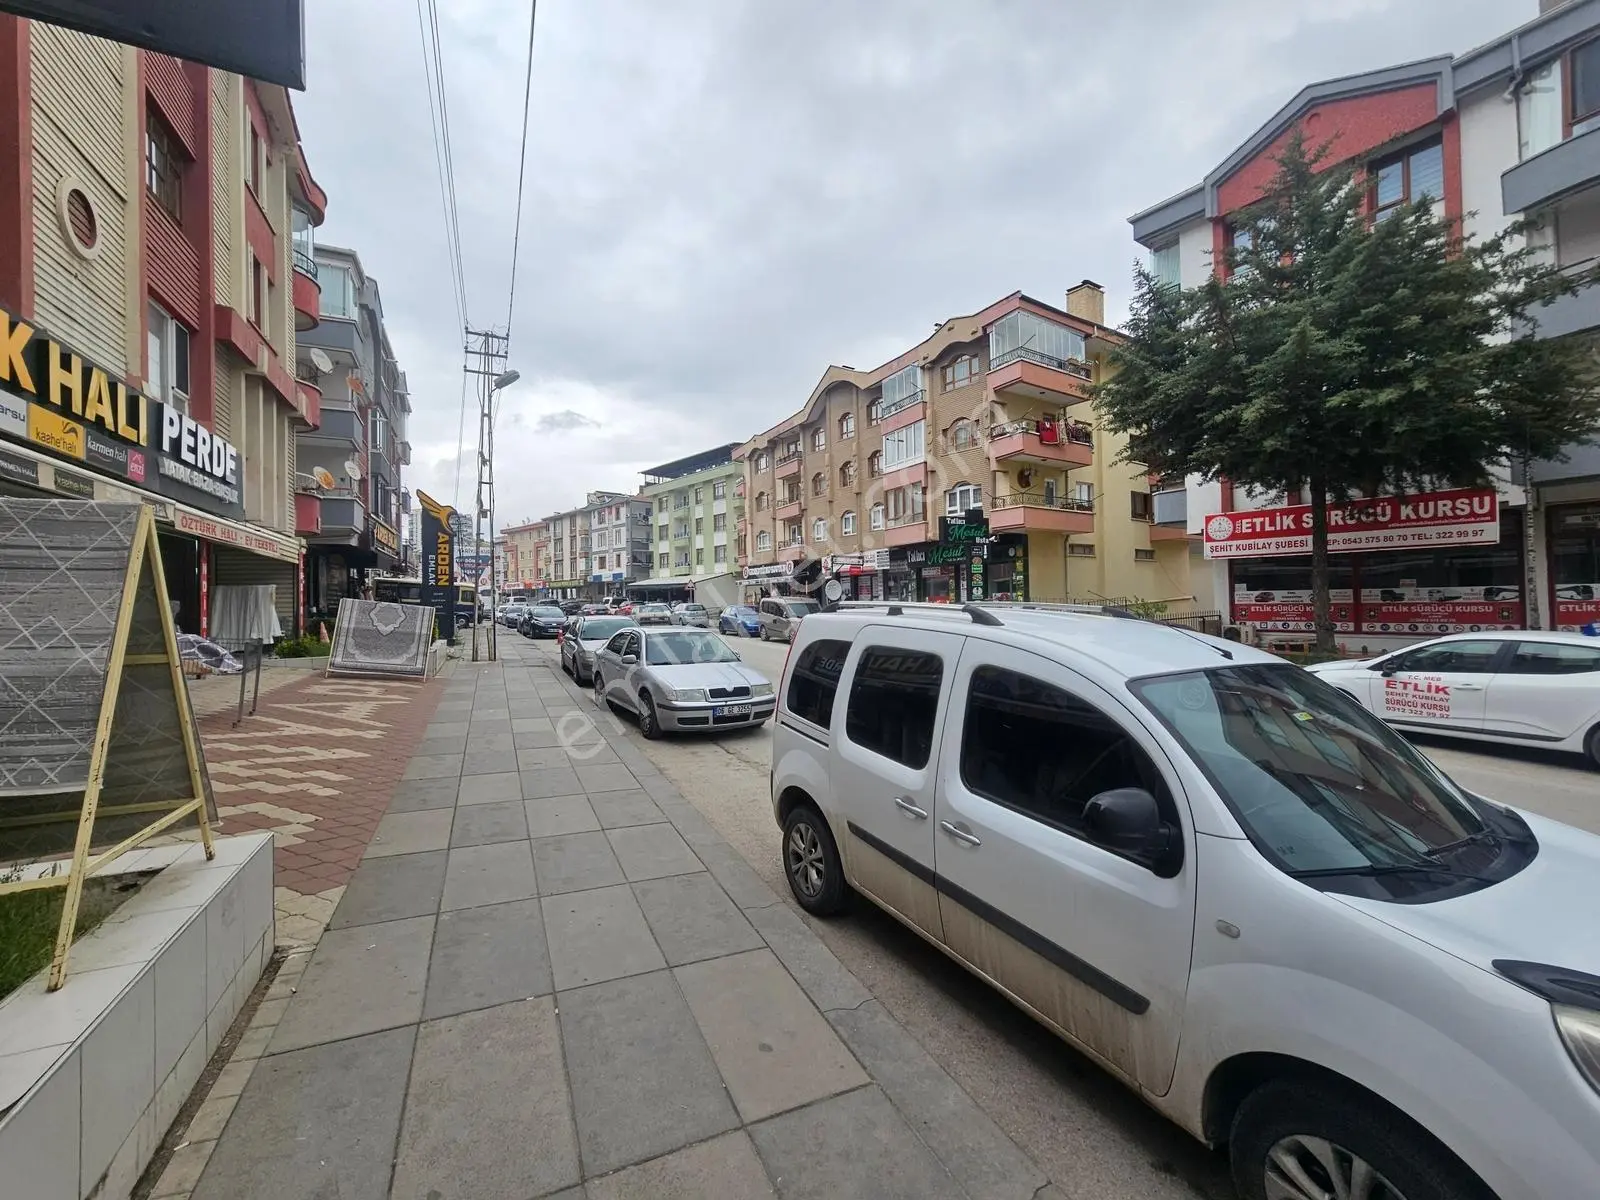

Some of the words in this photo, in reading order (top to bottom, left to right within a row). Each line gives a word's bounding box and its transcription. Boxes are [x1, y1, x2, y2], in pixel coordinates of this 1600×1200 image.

[49, 339, 147, 447] HALI
[162, 402, 237, 485] PERDE
[1242, 512, 1296, 533] ETLİK
[1401, 496, 1491, 520] KURSU
[948, 524, 987, 541] Mesut
[1342, 536, 1363, 545] 0543
[1365, 535, 1381, 544] 575
[1383, 534, 1394, 543] 80
[1396, 533, 1408, 542] 70
[1410, 532, 1433, 541] TEL:
[1435, 531, 1454, 540] 322
[1457, 529, 1469, 538] 99
[1472, 529, 1485, 537] 97
[1210, 543, 1233, 553] ŞEHİT
[1235, 540, 1273, 551] KUBİLAY
[1275, 538, 1309, 550] ŞUBESİ
[437, 532, 450, 586] ARDEN
[928, 545, 963, 564] Mesut
[428, 554, 436, 586] EMLAK
[1251, 604, 1272, 612] ETLİK
[1273, 604, 1305, 612] SÜRÜCÜ
[1382, 604, 1409, 612] ETLİK
[1411, 604, 1453, 612] SÜRÜCÜ
[1385, 680, 1451, 696] ETLİK
[1385, 697, 1418, 708] SÜRÜCÜ
[1420, 703, 1450, 712] KURSU
[1386, 706, 1406, 714] 0312
